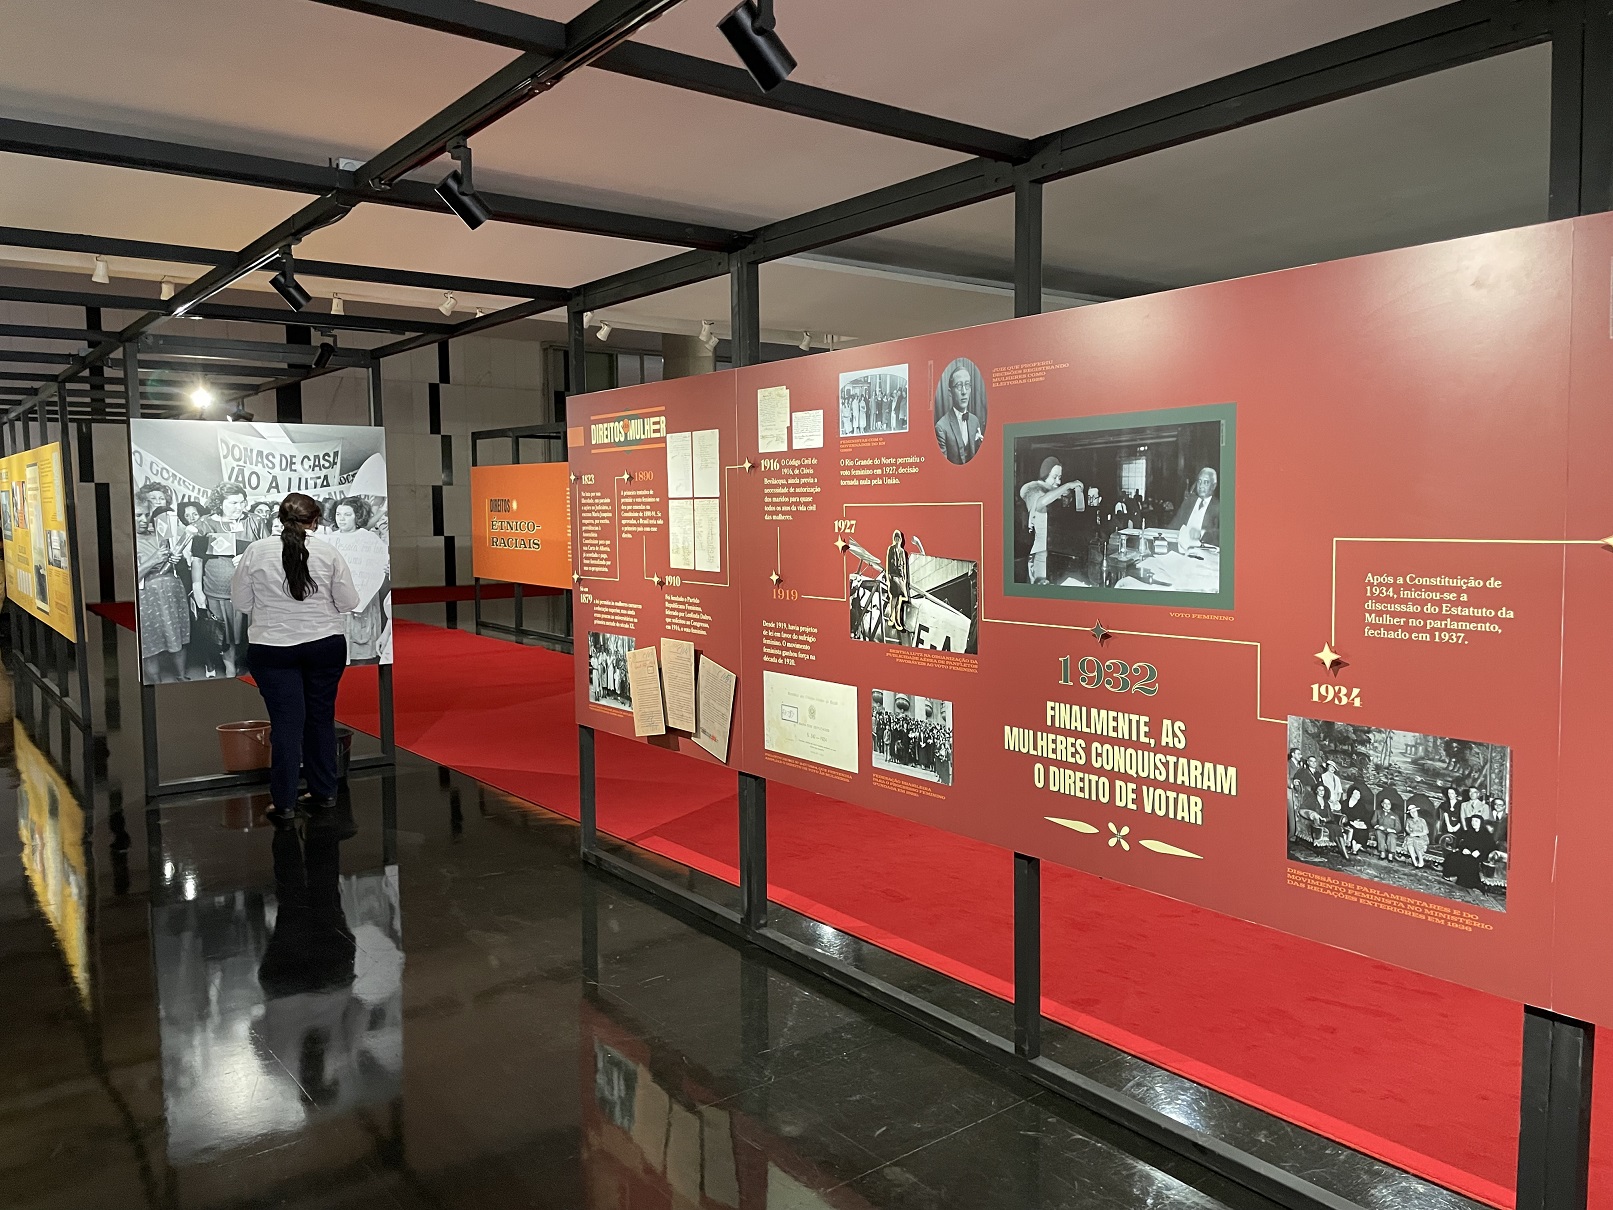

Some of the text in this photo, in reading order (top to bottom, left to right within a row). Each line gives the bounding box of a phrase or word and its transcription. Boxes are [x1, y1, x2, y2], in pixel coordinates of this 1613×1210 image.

[591, 416, 666, 444] DIREITOS MULHER
[279, 454, 297, 472] DE
[301, 450, 339, 471] CASA
[761, 459, 779, 471] 1916
[897, 455, 919, 464] permitiu
[635, 471, 653, 481] 1890
[872, 478, 882, 486] pela
[490, 499, 510, 513] DIREITOS
[491, 517, 541, 533] ÉTNICO-
[834, 520, 856, 533] 1927
[491, 536, 541, 551] RACIAIS
[665, 576, 680, 586] 1910
[1365, 573, 1502, 589] Após a Constituição de
[773, 588, 798, 600] 1919
[1366, 586, 1468, 601] 1934, iniciou-se a
[1192, 613, 1235, 621] FEMININO
[1365, 600, 1514, 619] discussão do Estatuto da
[1365, 613, 1502, 634] Mulher no parlamento,
[799, 634, 816, 643] sufrágio
[1364, 626, 1469, 644] fechado em 1937.
[798, 652, 809, 660] força
[1059, 654, 1159, 696] 1932
[1310, 683, 1362, 708] 1934
[1046, 700, 1186, 750] FINALMENTE, AS
[1004, 725, 1237, 796] MULHERES CONQUISTARAM
[1034, 762, 1203, 825] O DIREITO DE VOTAR
[1287, 873, 1346, 893] MOVIMENTO
[1348, 889, 1405, 908] FEMINISTA
[1287, 867, 1340, 885] DISCUSSÃO
[1356, 886, 1451, 913] PARLAMENTARES
[1453, 907, 1460, 915] E
[1462, 911, 1479, 920] DO
[1287, 880, 1306, 888] DAS
[1307, 885, 1358, 902] RELAÇÕES
[1360, 898, 1425, 920] EXTERIORES
[1427, 916, 1445, 925] EM
